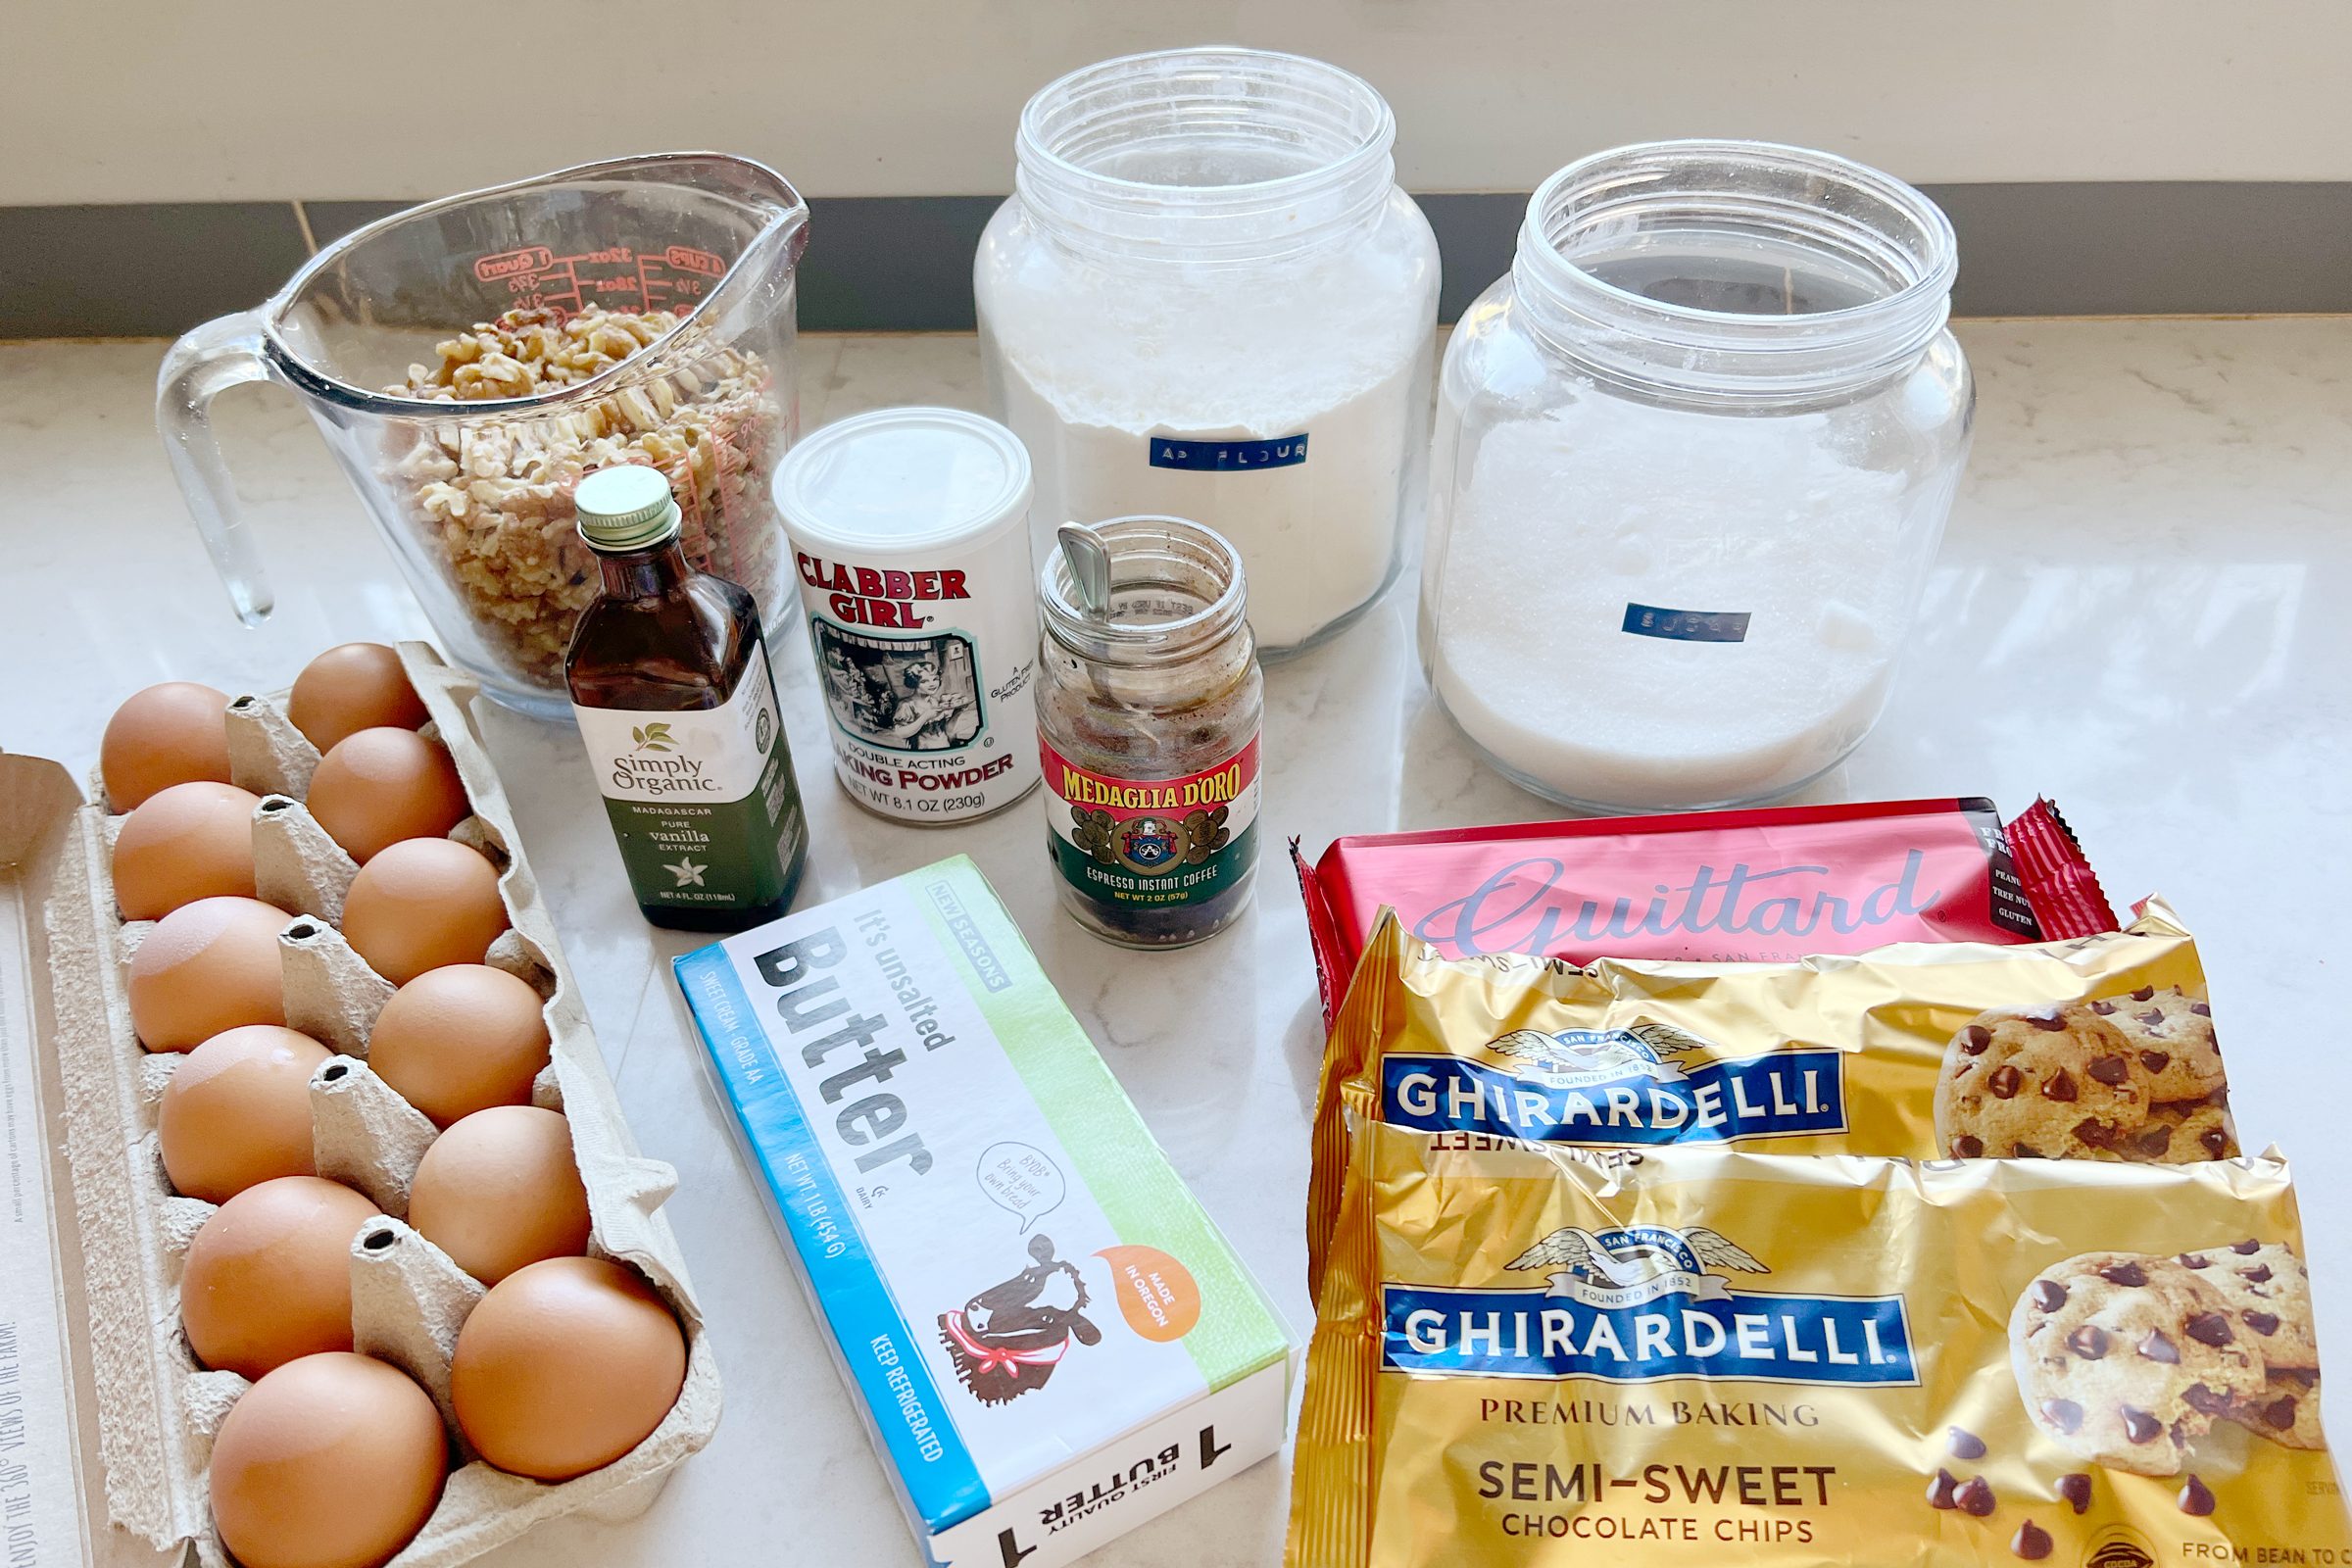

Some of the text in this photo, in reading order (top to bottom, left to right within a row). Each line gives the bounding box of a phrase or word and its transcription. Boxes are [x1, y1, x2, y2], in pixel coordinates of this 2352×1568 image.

[1162, 447, 1187, 460] AP
[797, 551, 971, 601] CLABBER
[829, 593, 926, 629] GIRL
[613, 754, 704, 781] Simply
[834, 746, 1014, 792] AKING POWDER
[848, 741, 966, 769] DOUBLE ACTING
[612, 769, 716, 796] Organic
[848, 775, 986, 814] NET WT 8.1 OZ (230g)
[1062, 764, 1179, 809] MEDAGLIA
[632, 806, 712, 816] MADAGASCAR
[661, 820, 691, 829] PURE
[649, 830, 710, 843] vanilla
[659, 843, 708, 853] EXTRACT
[1087, 864, 1218, 891] ESPRESSO INSTANT COFFEE
[1114, 891, 1129, 901] NET
[1132, 893, 1146, 902] WT
[1413, 848, 1940, 956] Guittard
[1998, 906, 2033, 926] GLUTEN
[931, 884, 1005, 990] NEW SEASONS
[854, 907, 956, 1053] It's unsalted
[700, 970, 727, 999] SWEET
[730, 1036, 759, 1069] GRADE
[745, 1068, 764, 1086] AA
[1562, 1030, 1650, 1060] SAN FRANCISCO
[753, 925, 934, 1177] Butter
[1549, 1074, 1608, 1086] FOUNDED
[1610, 1069, 1624, 1078] IN
[1396, 1070, 1821, 1129] GHIRARDELLI
[784, 1152, 809, 1176] NET
[807, 1200, 828, 1217] LB
[856, 1187, 874, 1210] DAIRY
[1604, 1231, 1694, 1269] SAN FRANCISCO
[1124, 1264, 1169, 1328] IN OREGON
[1149, 1272, 1176, 1306] MADE
[1582, 1288, 1642, 1303] FOUNDED
[1647, 1284, 1660, 1295] IN
[1403, 1308, 1888, 1365] GHIRARDELLI
[869, 1333, 944, 1463] KEEP REFRIGERATED
[1481, 1396, 1819, 1428] PREMIUM BAKING
[0, 1408, 26, 1452] VIEWS
[1039, 1443, 1181, 1526] BUTTER
[1048, 1464, 1177, 1536] FIRST QUALITY
[1477, 1459, 1837, 1507] SEMI-SWEET
[5, 1493, 32, 1521] THE
[1501, 1512, 1814, 1544] CHOCOLATE CHIPS
[2181, 1542, 2248, 1564] FROM
[2256, 1547, 2306, 1565] BEAN
[2314, 1548, 2335, 1565] TO
